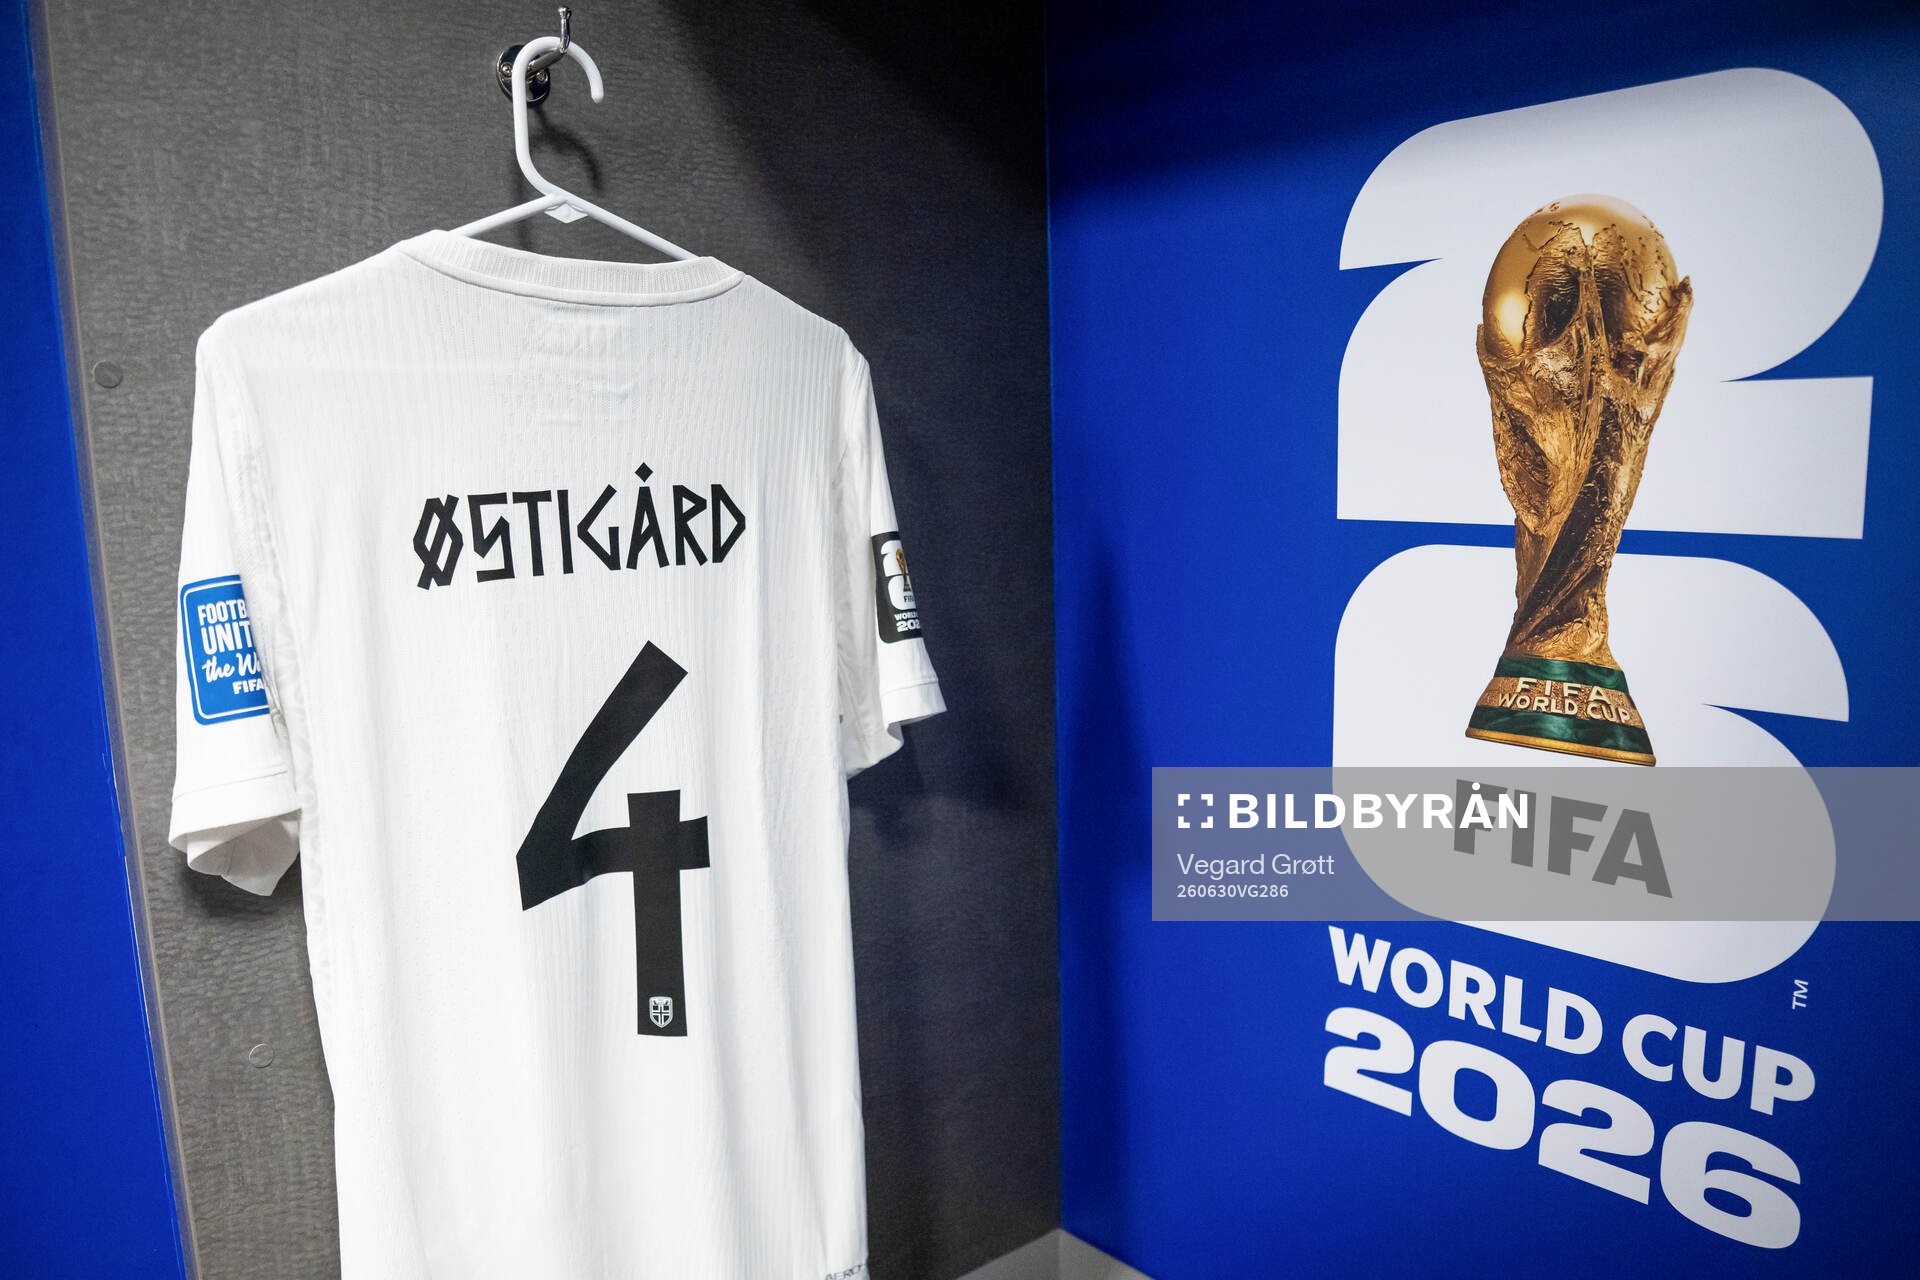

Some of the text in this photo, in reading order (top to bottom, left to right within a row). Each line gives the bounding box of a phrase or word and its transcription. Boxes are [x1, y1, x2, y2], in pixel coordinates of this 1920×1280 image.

[412, 461, 747, 591] ØSTIGÅRD
[197, 599, 247, 627] FOOTB
[200, 620, 253, 656] UNIT
[201, 655, 235, 684] the
[232, 678, 265, 694] FIFA
[1498, 691, 1632, 724] WORLD CUP
[1515, 677, 1610, 702] FIFA
[515, 640, 711, 1037] 4
[1454, 778, 1674, 899] FIFA
[1327, 925, 1817, 1116] WORLD CUP
[1323, 1006, 1802, 1250] 2026
